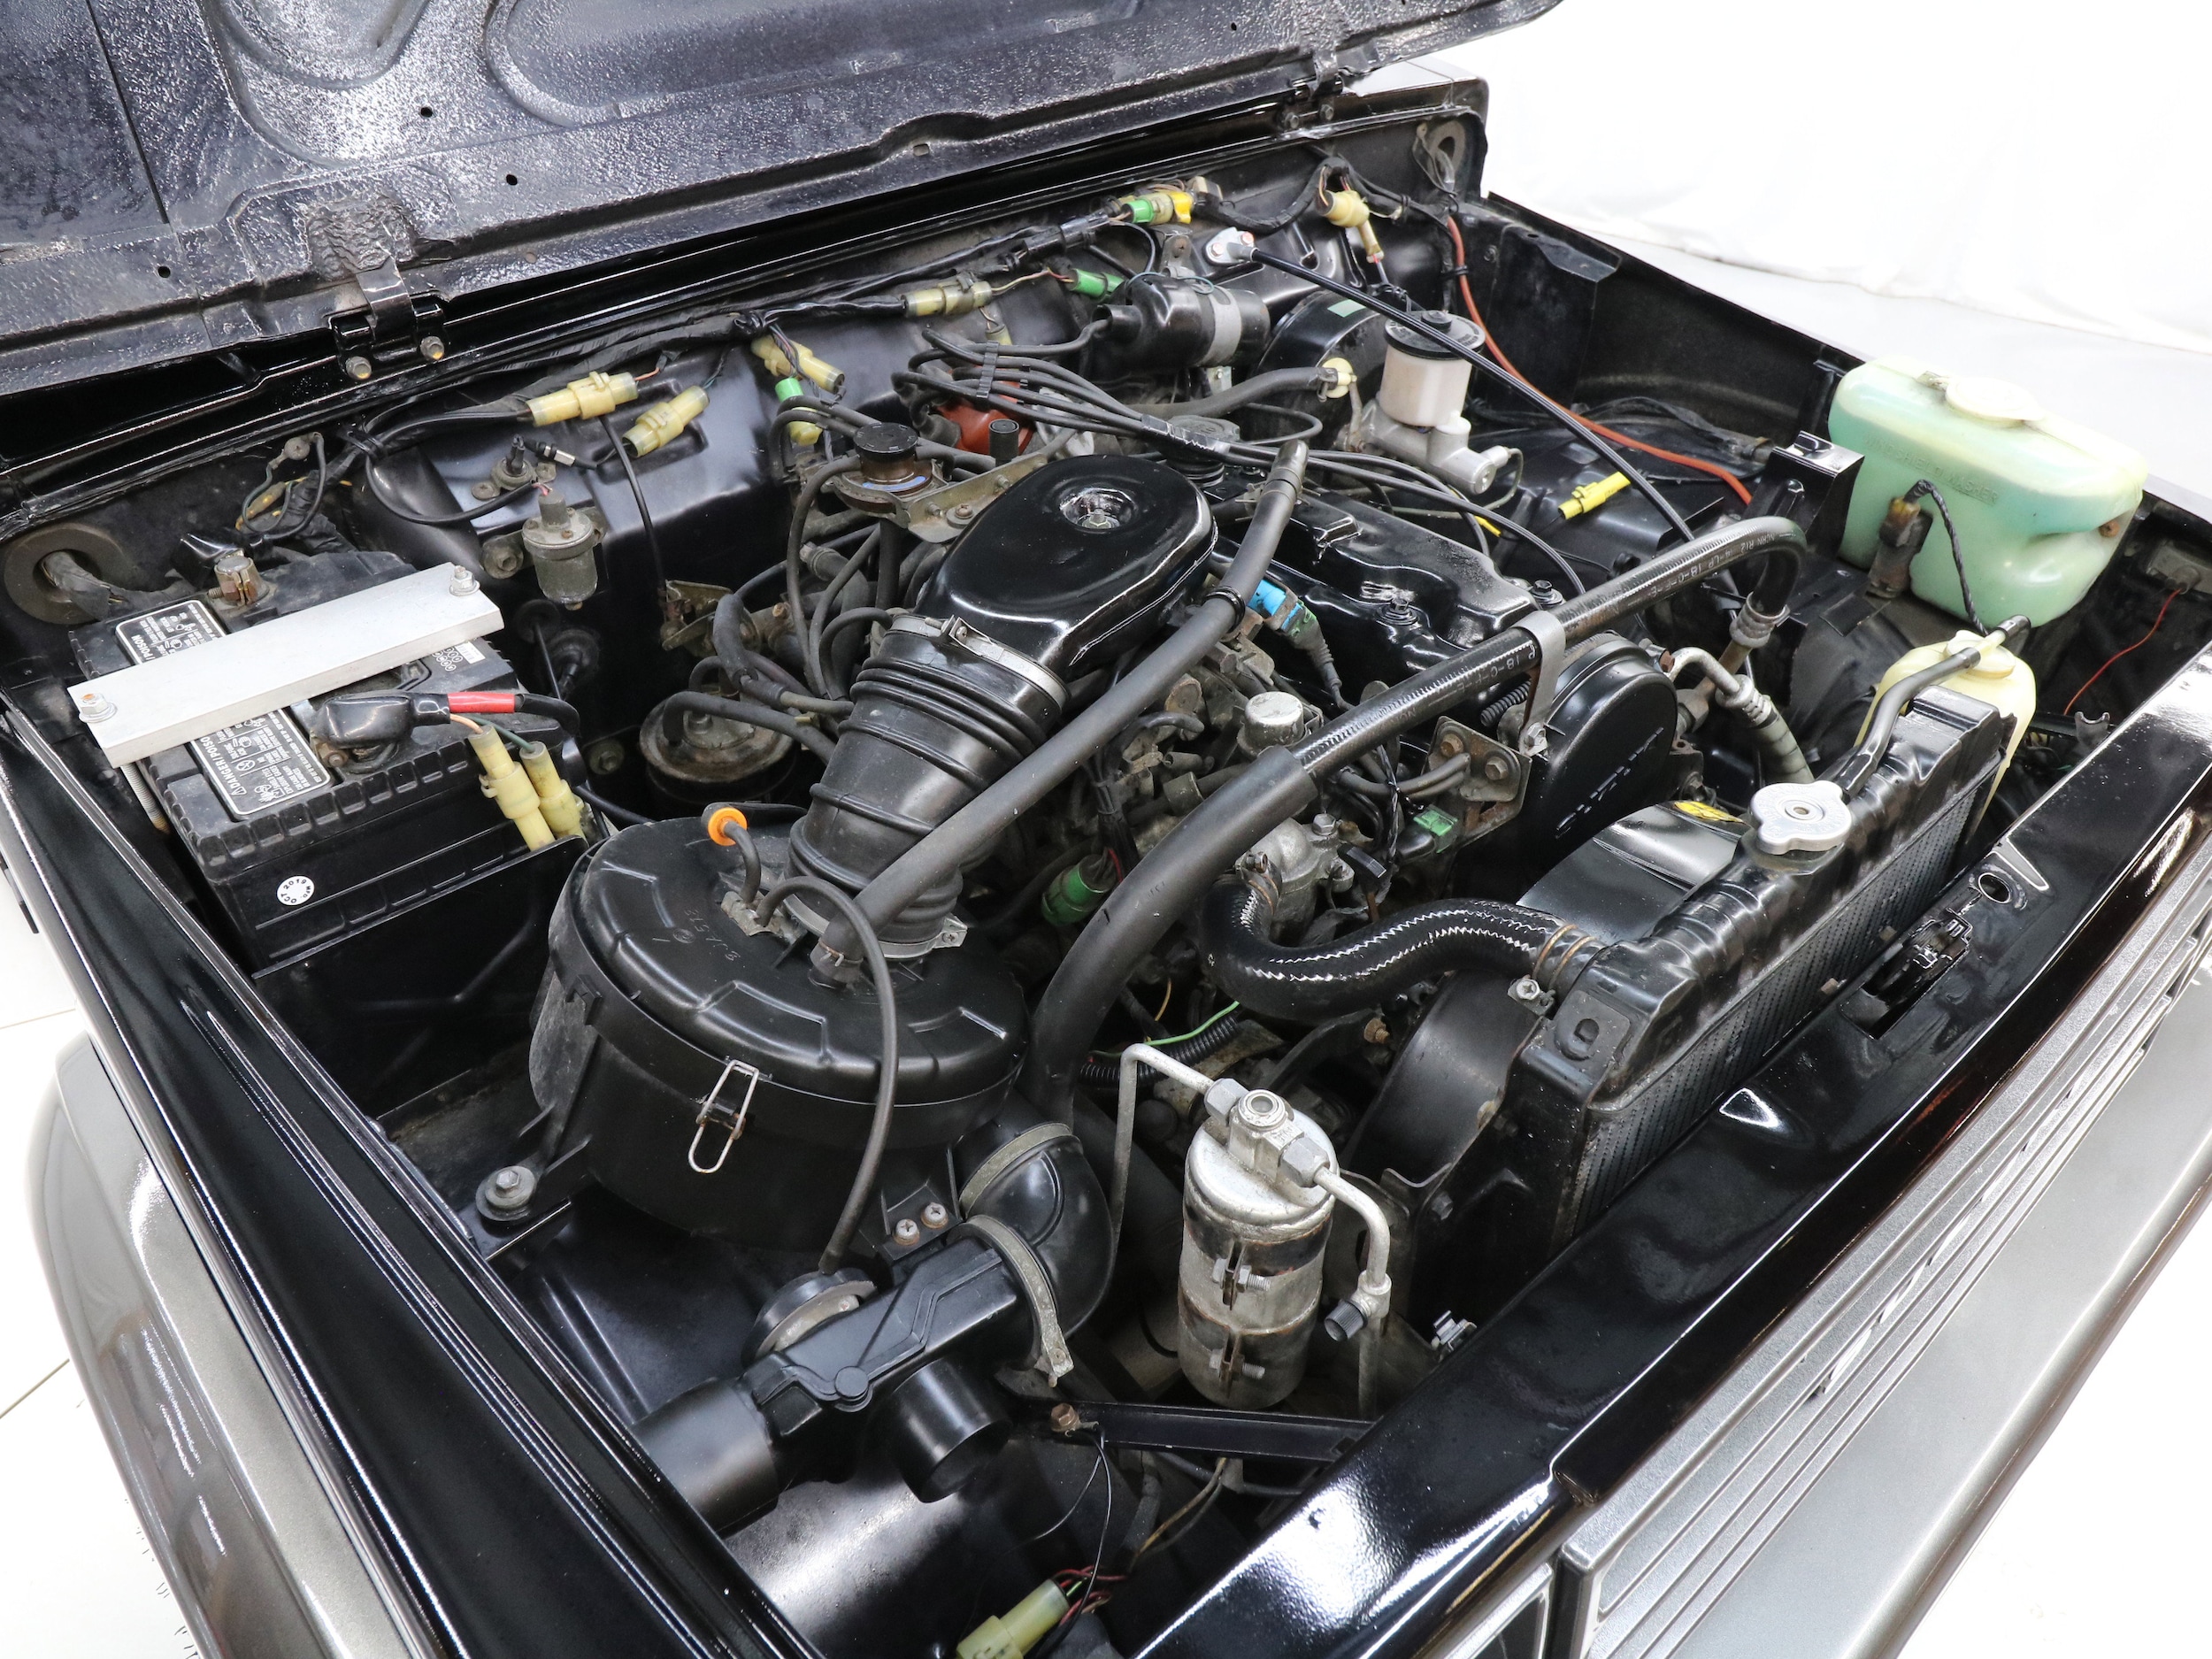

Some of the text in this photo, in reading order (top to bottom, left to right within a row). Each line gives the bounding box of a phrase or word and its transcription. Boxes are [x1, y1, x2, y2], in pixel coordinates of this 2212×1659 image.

[200, 736, 242, 787] DANGER/POISO
[283, 878, 307, 890] 2019
[280, 893, 297, 904] OCT
